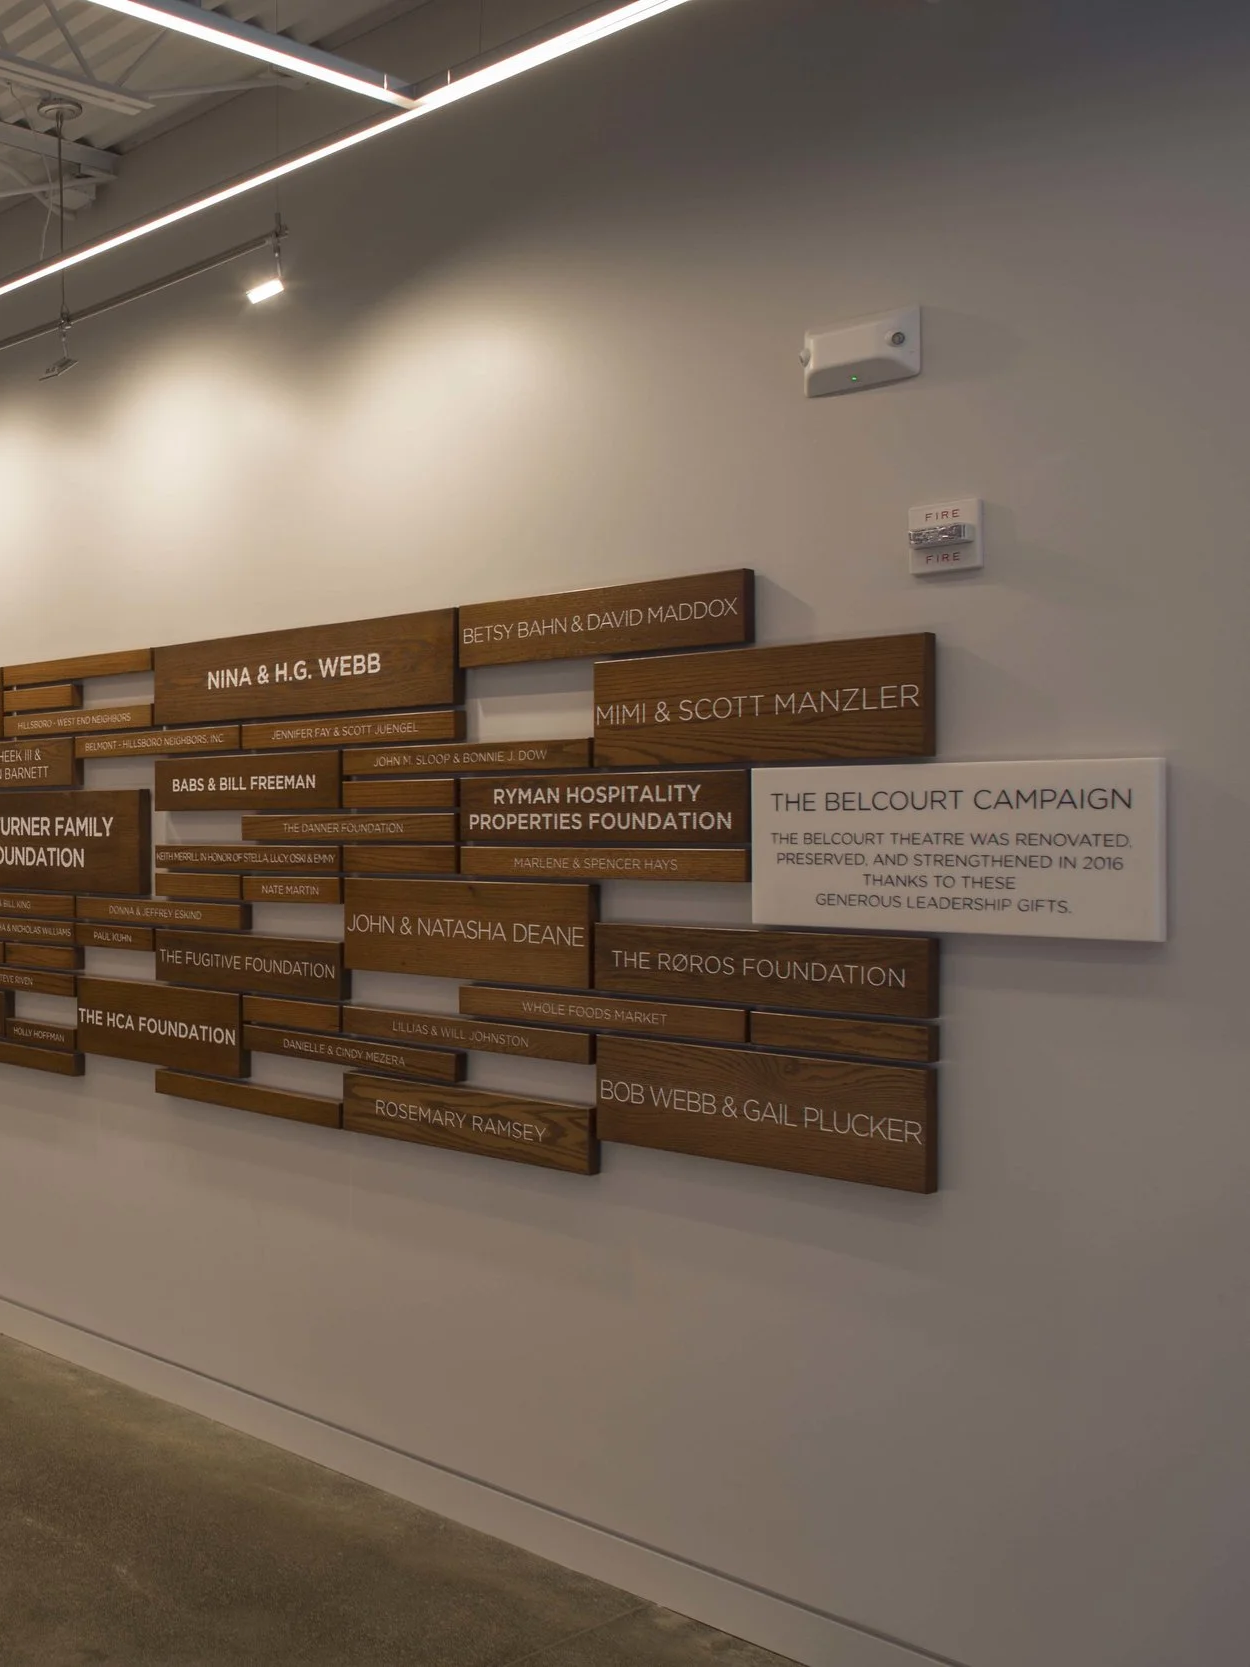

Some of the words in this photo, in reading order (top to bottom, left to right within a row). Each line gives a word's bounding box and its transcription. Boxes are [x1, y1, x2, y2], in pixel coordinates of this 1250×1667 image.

[926, 509, 960, 521] FIRE
[926, 552, 960, 564] FIRE
[464, 624, 514, 645] BETSY
[518, 618, 567, 638] BAHN
[571, 616, 583, 633] &
[588, 608, 643, 631] DAVID
[648, 597, 738, 624] MADDOX
[207, 668, 252, 690] NINA
[257, 665, 269, 684] &
[276, 660, 312, 682] H.G.
[319, 652, 381, 678] WEBB
[596, 702, 646, 726] MIMI
[655, 702, 670, 722] &
[679, 694, 764, 722] SCOTT
[775, 684, 920, 716] MANZLER
[18, 720, 52, 730] HILLSBORO
[57, 716, 75, 727] WEST
[76, 716, 90, 726] END
[92, 712, 131, 724] NEIGHBORS
[272, 727, 312, 740] JENNIFER
[315, 726, 332, 738] FAY
[333, 726, 340, 737] &
[342, 724, 372, 737] SCOTT
[374, 722, 418, 736] JUENGEL
[34, 748, 42, 761] &
[374, 756, 400, 767] JOHN
[416, 754, 450, 766] SLOOP
[453, 754, 460, 764] &
[463, 751, 504, 764] BONNIE
[508, 751, 515, 762] J.
[518, 750, 547, 762] DOW
[4, 766, 48, 780] BARNETT
[172, 778, 204, 792] BABS
[208, 778, 216, 791] &
[220, 776, 246, 791] BILL
[250, 774, 316, 790] FREEMAN
[494, 787, 560, 805] RYMAN
[567, 784, 700, 804] HOSPITALITY
[771, 792, 816, 812] THE
[826, 790, 963, 811] BELCOURT
[974, 788, 1132, 810] CAMPAIGN
[55, 816, 113, 836] FAMILY
[284, 822, 300, 832] THE
[302, 822, 339, 833] DANNER
[342, 822, 404, 833] FOUNDATION
[469, 813, 582, 830] PROPERTIES
[589, 812, 732, 830] FOUNDATION
[771, 832, 798, 845] THE
[804, 832, 883, 846] BELCOURT
[890, 832, 964, 846] THEATRE
[970, 833, 1010, 846] WAS
[1016, 833, 1132, 848] RENOVATED,
[514, 857, 570, 868] MARLENE
[573, 858, 581, 868] &
[584, 858, 640, 870] SPENCER
[644, 858, 678, 872] HAYS
[777, 852, 868, 867] PRESERVED,
[874, 853, 908, 866] AND
[914, 854, 1052, 869] STRENGTHENED
[1058, 856, 1076, 870] IN
[1082, 856, 1123, 870] 2016
[262, 885, 284, 896] NATE
[286, 886, 319, 896] MARTIN
[864, 874, 928, 888] THANKS
[934, 876, 955, 889] TO
[962, 876, 1016, 890] THESE
[109, 905, 134, 915] DONNA
[144, 907, 172, 918] JEFFREY
[174, 910, 202, 920] ESKIND
[816, 894, 902, 909] GENEROUS
[907, 896, 1012, 912] LEADERSHIP
[1018, 899, 1072, 914] GIFTS.
[94, 932, 110, 941] PAUL
[112, 933, 132, 942] KUHN
[347, 914, 395, 935] JOHN
[400, 916, 412, 936] &
[417, 918, 506, 942] NATASHA
[514, 922, 585, 948] DEANE
[160, 949, 182, 964] THE
[186, 951, 241, 970] FUGITIVE
[246, 956, 335, 979] FOUNDATION
[612, 950, 650, 970] THE
[658, 952, 735, 976] RØROS
[742, 958, 906, 988] FOUNDATION
[522, 1001, 564, 1017] WHOLE
[568, 1005, 610, 1021] FOODS
[614, 1008, 667, 1026] MARKET
[14, 1026, 32, 1037] HOLLY
[34, 1030, 64, 1042] HOFFMAN
[79, 1008, 102, 1026] THE
[107, 1012, 134, 1031] HCA
[139, 1016, 236, 1046] FOUNDATION
[393, 1021, 428, 1036] LILLIAS
[430, 1024, 438, 1038] &
[440, 1026, 466, 1040] WILL
[468, 1029, 528, 1048] JOHNSTON
[284, 1038, 324, 1053] DANIELLE
[328, 1044, 334, 1055] &
[336, 1046, 364, 1060] CINDY
[366, 1050, 405, 1066] MEZERA
[376, 1100, 466, 1129] ROSEMARY
[472, 1116, 547, 1143] RAMSEY
[601, 1080, 644, 1105] BOB
[650, 1086, 716, 1116] WEBB
[722, 1097, 738, 1118] &
[744, 1099, 796, 1126] GAIL
[804, 1108, 922, 1146] PLUCKER
